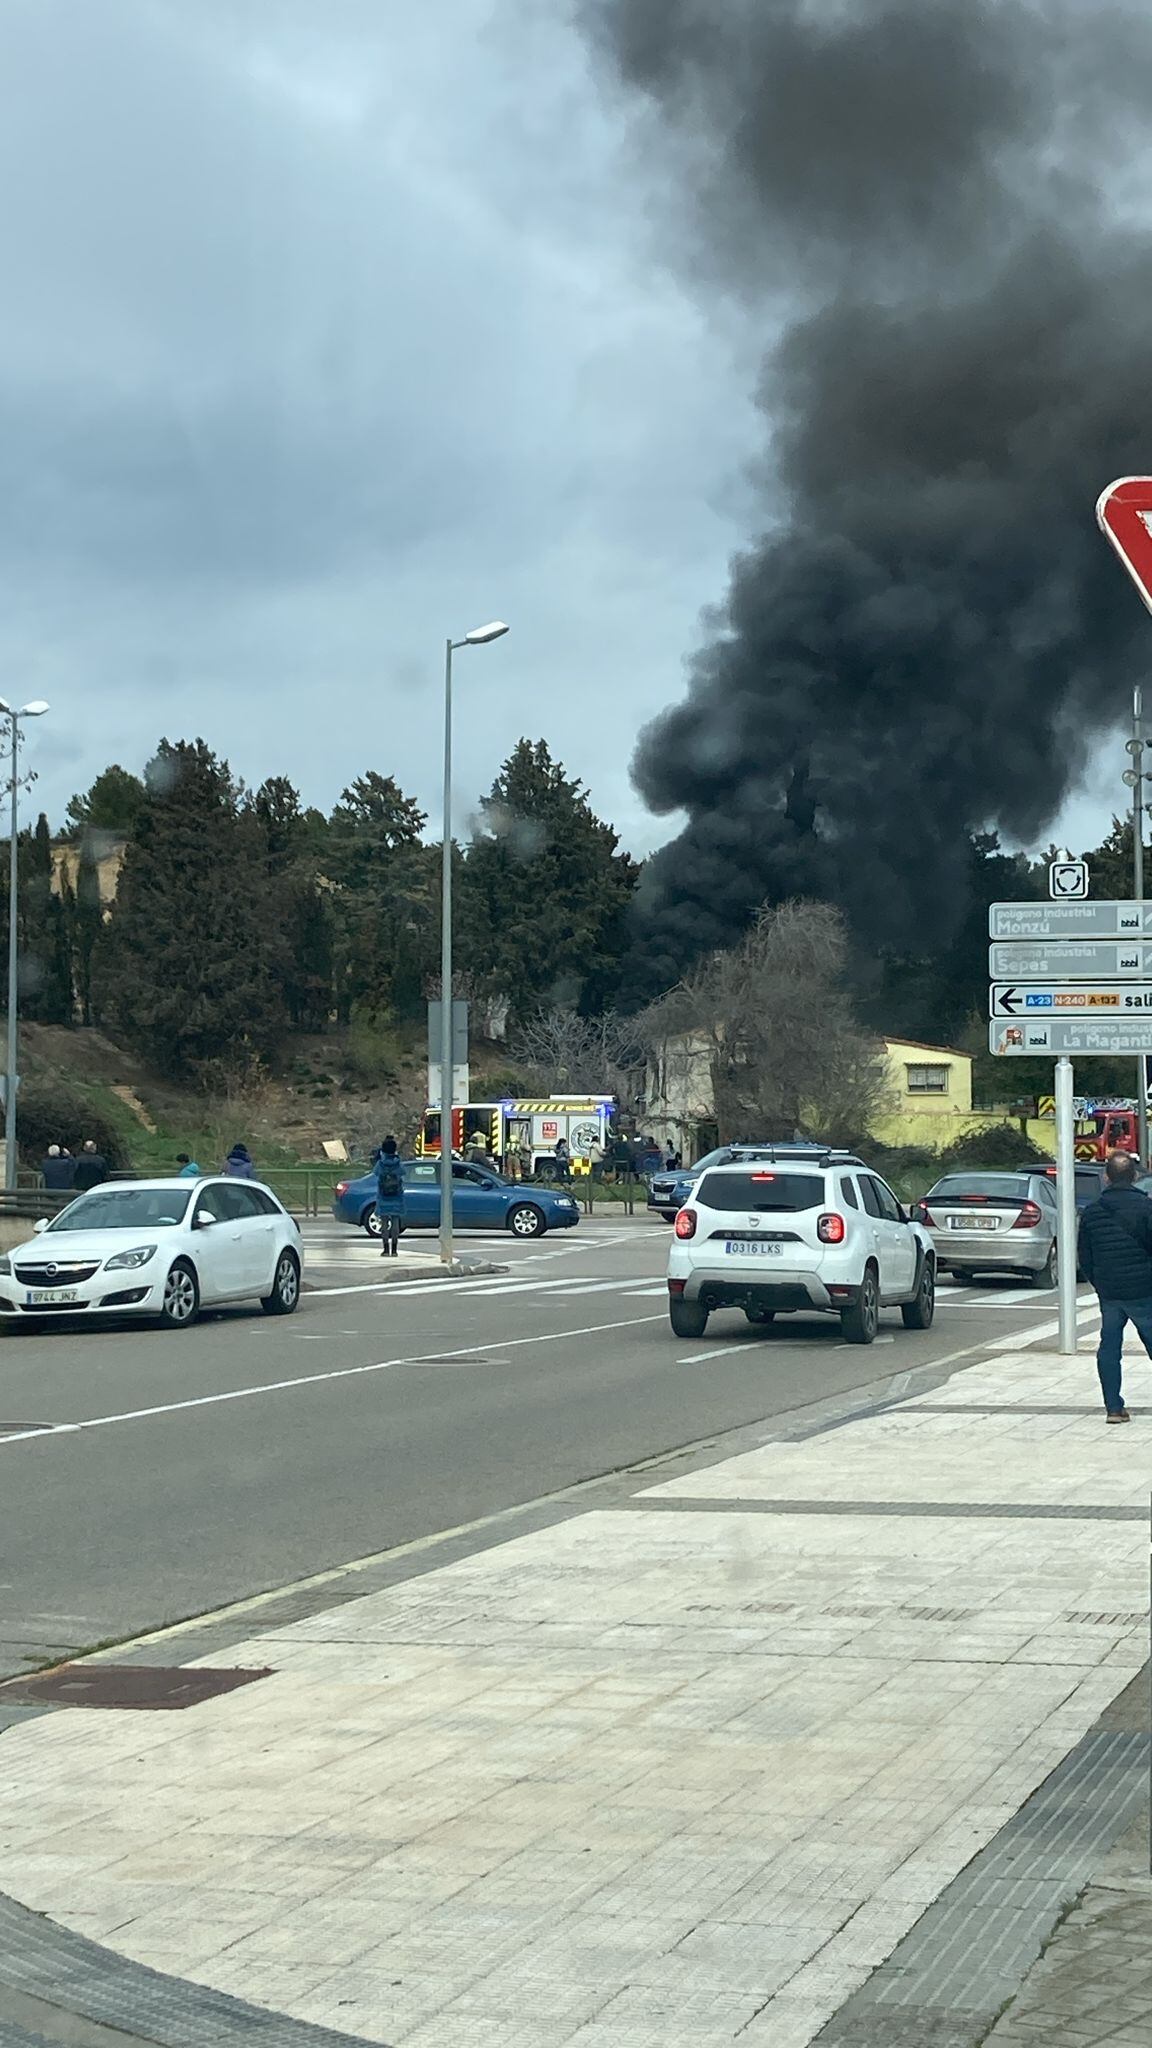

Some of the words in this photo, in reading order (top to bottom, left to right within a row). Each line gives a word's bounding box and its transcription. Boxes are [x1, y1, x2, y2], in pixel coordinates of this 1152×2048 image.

[1044, 908, 1096, 918] industrial
[997, 919, 1050, 934] Monzú
[1044, 947, 1096, 957] industrial
[998, 959, 1049, 975] Sepes
[1028, 996, 1051, 1005] A-23
[1054, 996, 1085, 1005] N-240
[1064, 1034, 1081, 1047] La
[732, 1242, 758, 1253] 0316
[761, 1244, 781, 1254] LKS
[59, 1291, 77, 1302] JNZ
